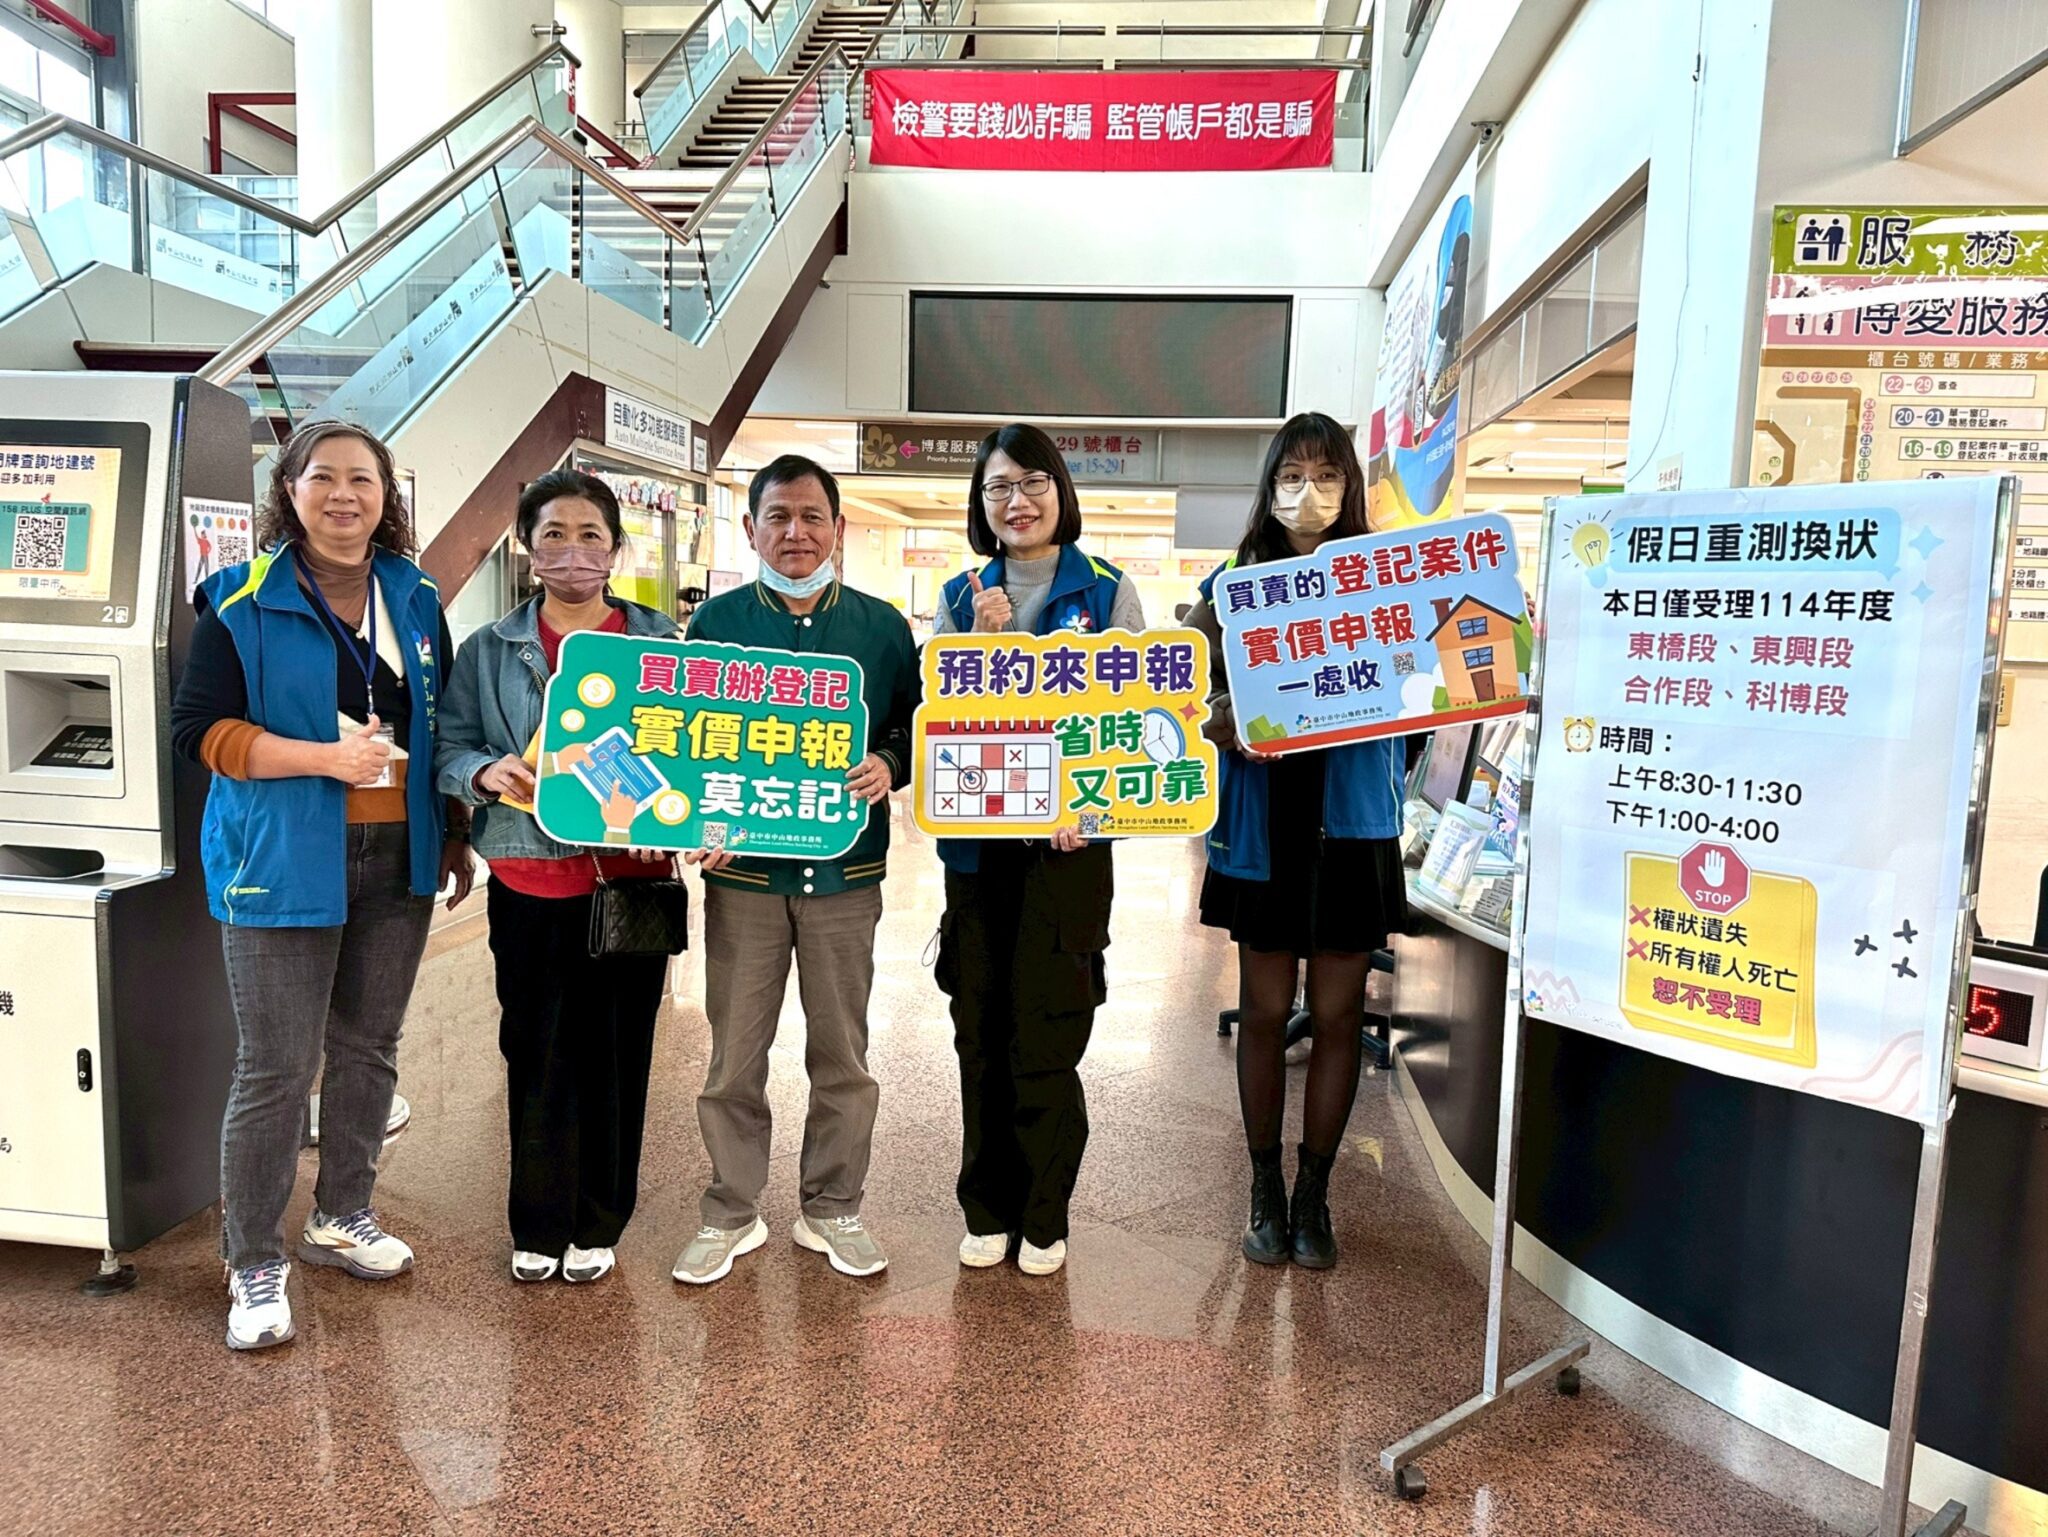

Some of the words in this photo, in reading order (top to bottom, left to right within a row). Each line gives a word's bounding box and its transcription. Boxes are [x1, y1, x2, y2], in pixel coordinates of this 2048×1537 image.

[892, 98, 1091, 141] 檢警要錢必詐騙
[1105, 100, 1314, 141] 監管帳戶都是騙
[613, 401, 686, 447] 自動化多功能服務區
[922, 439, 983, 454] 博愛服務
[1626, 519, 1879, 564] 假日重測換狀
[101, 606, 114, 623] 2
[1603, 589, 1894, 622] 本日僅受理114年度
[1242, 602, 1416, 668] 實價申報
[1627, 632, 1855, 669] 東橋段、東興段
[637, 654, 848, 709] 買賣辦登記
[938, 644, 1194, 696] 預約來申報
[1277, 658, 1382, 698] 一處收
[1623, 675, 1849, 717] 合作段、科博段
[630, 706, 851, 770] 實價申報
[1054, 710, 1143, 757] 省時
[699, 772, 858, 823] 莫忘記!
[1069, 759, 1206, 810] 又可靠
[1608, 762, 1803, 807] 上午8:30-11:30
[1605, 800, 1780, 844] 下午1:00-4:00
[1694, 889, 1732, 907] STOP
[1653, 907, 1749, 948] 權狀遺失
[1648, 941, 1799, 994] 所有權人死亡
[1652, 976, 1763, 1027] 恕不受理
